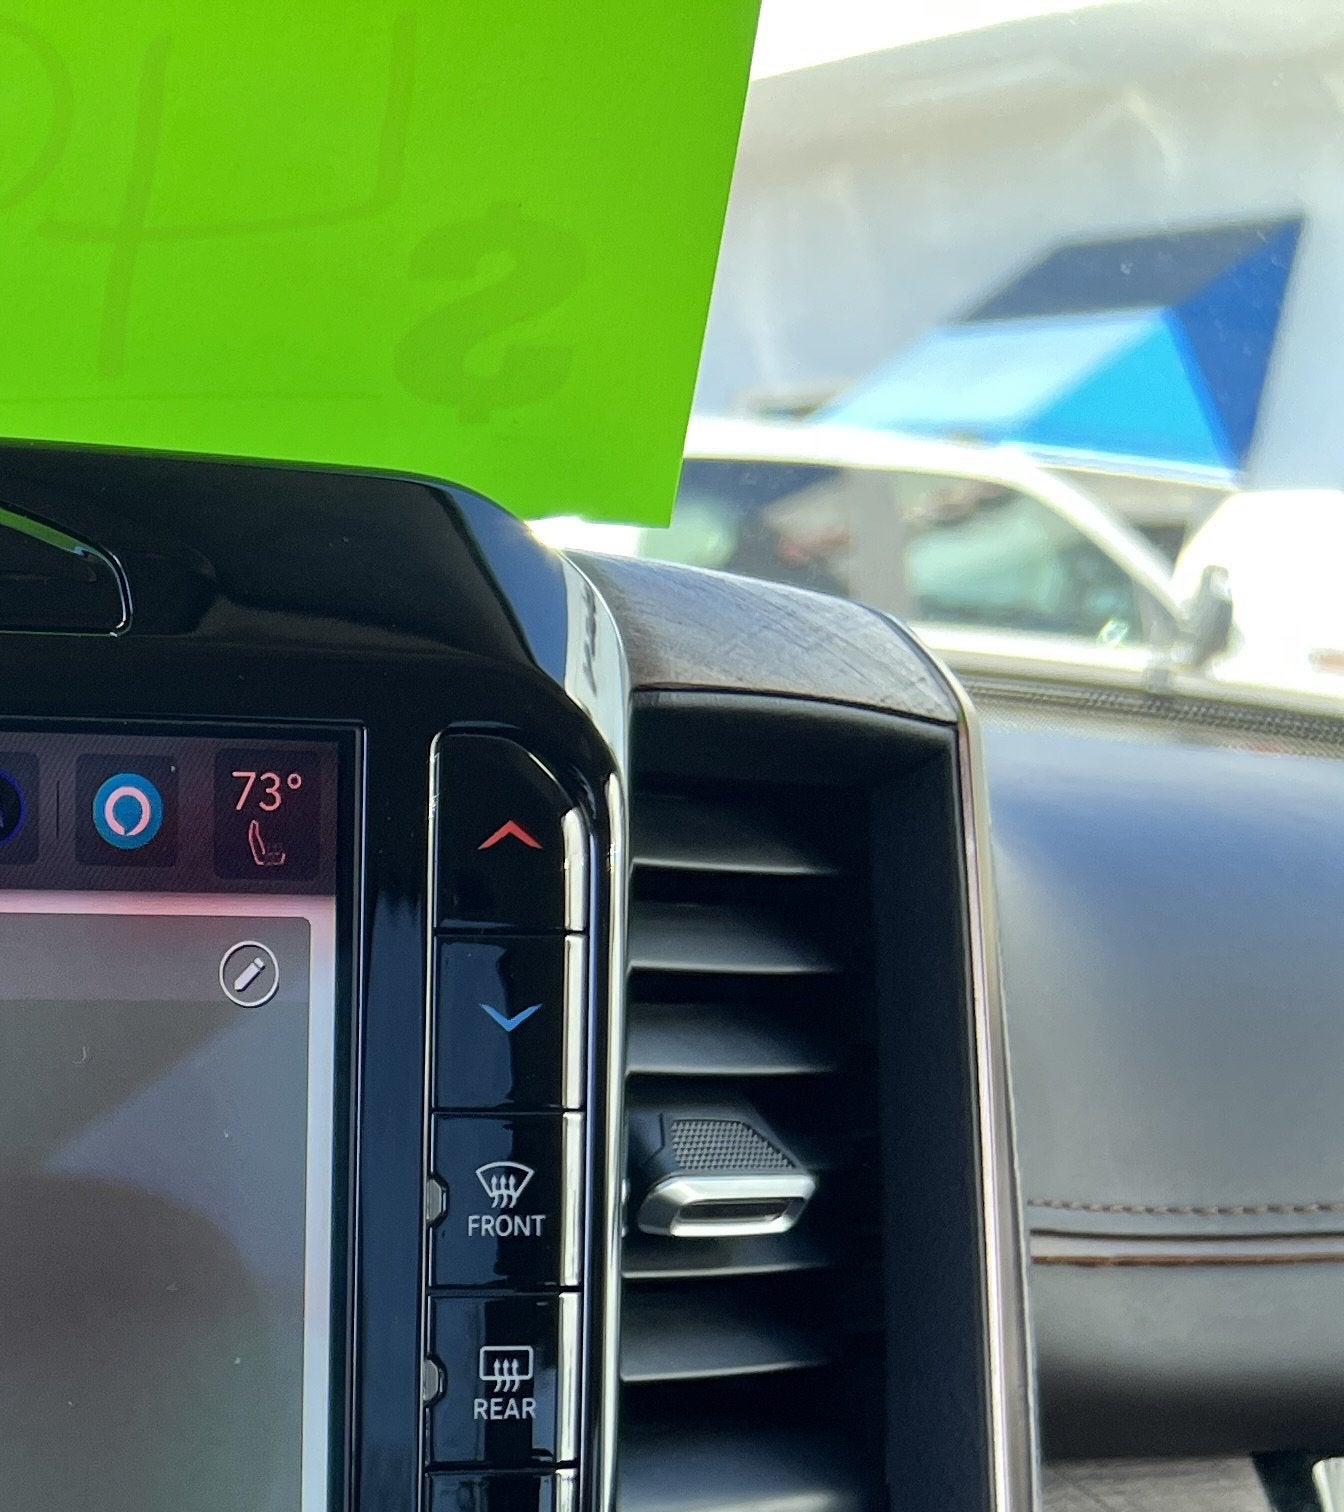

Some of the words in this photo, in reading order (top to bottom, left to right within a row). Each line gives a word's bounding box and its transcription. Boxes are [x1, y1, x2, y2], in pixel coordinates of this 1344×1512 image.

[231, 770, 302, 812] 73°
[467, 1214, 546, 1238] FRONT
[473, 1398, 537, 1421] REAR
